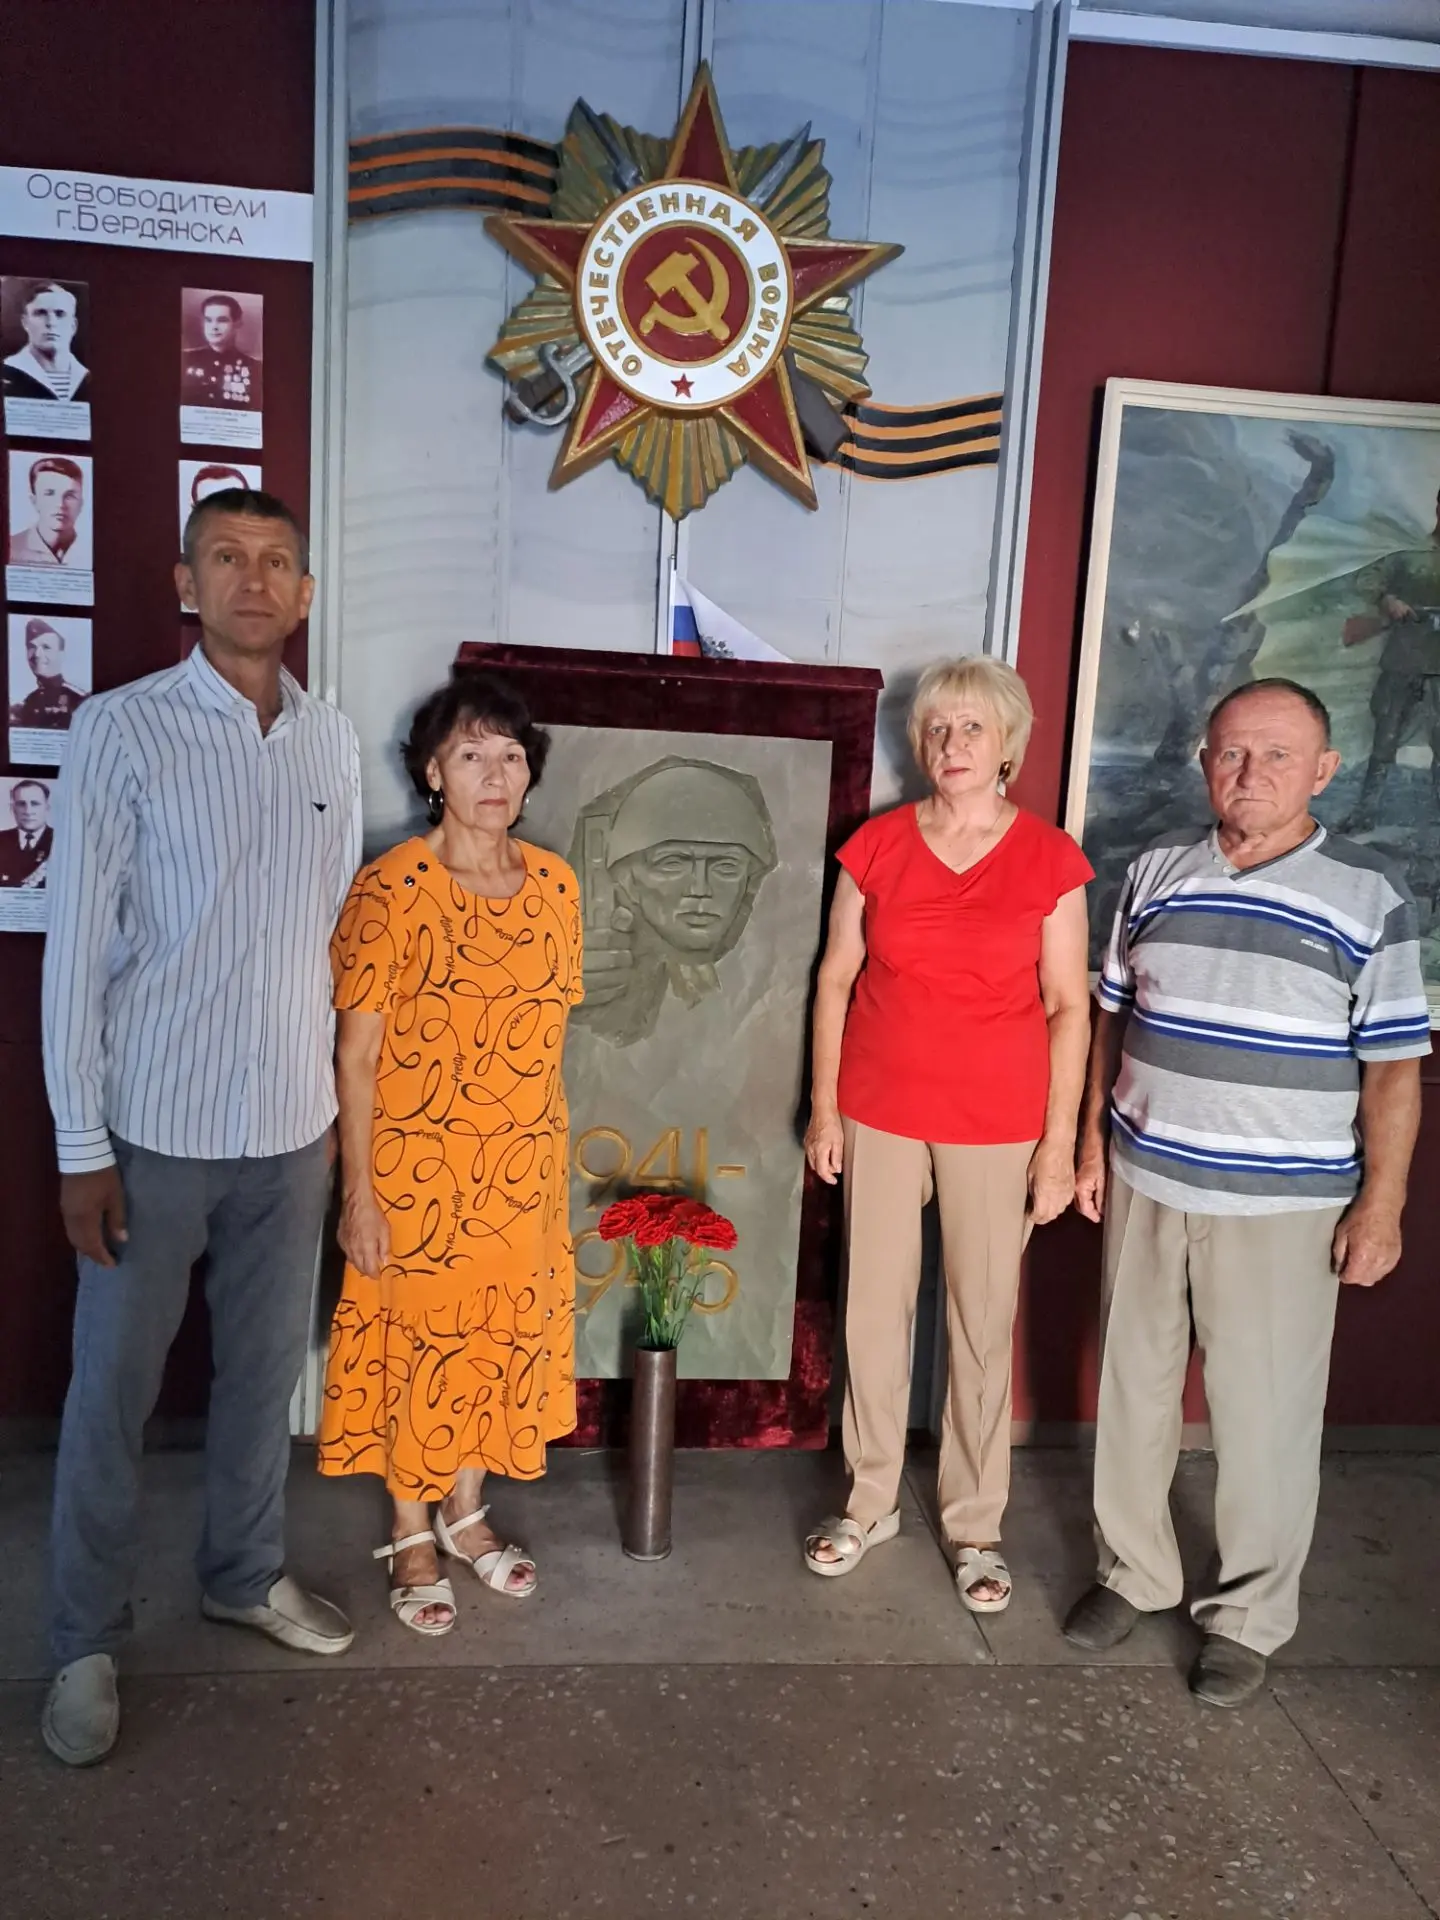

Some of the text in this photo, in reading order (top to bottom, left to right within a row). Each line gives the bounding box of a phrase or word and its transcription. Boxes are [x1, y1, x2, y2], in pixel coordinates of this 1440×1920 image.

[26, 173, 267, 219] Освободители
[56, 204, 244, 246] г.Бердянска
[589, 192, 780, 377] ОТЕЧЕСТВЕННАЯ ВОЙНА
[574, 1126, 747, 1212] 941-
